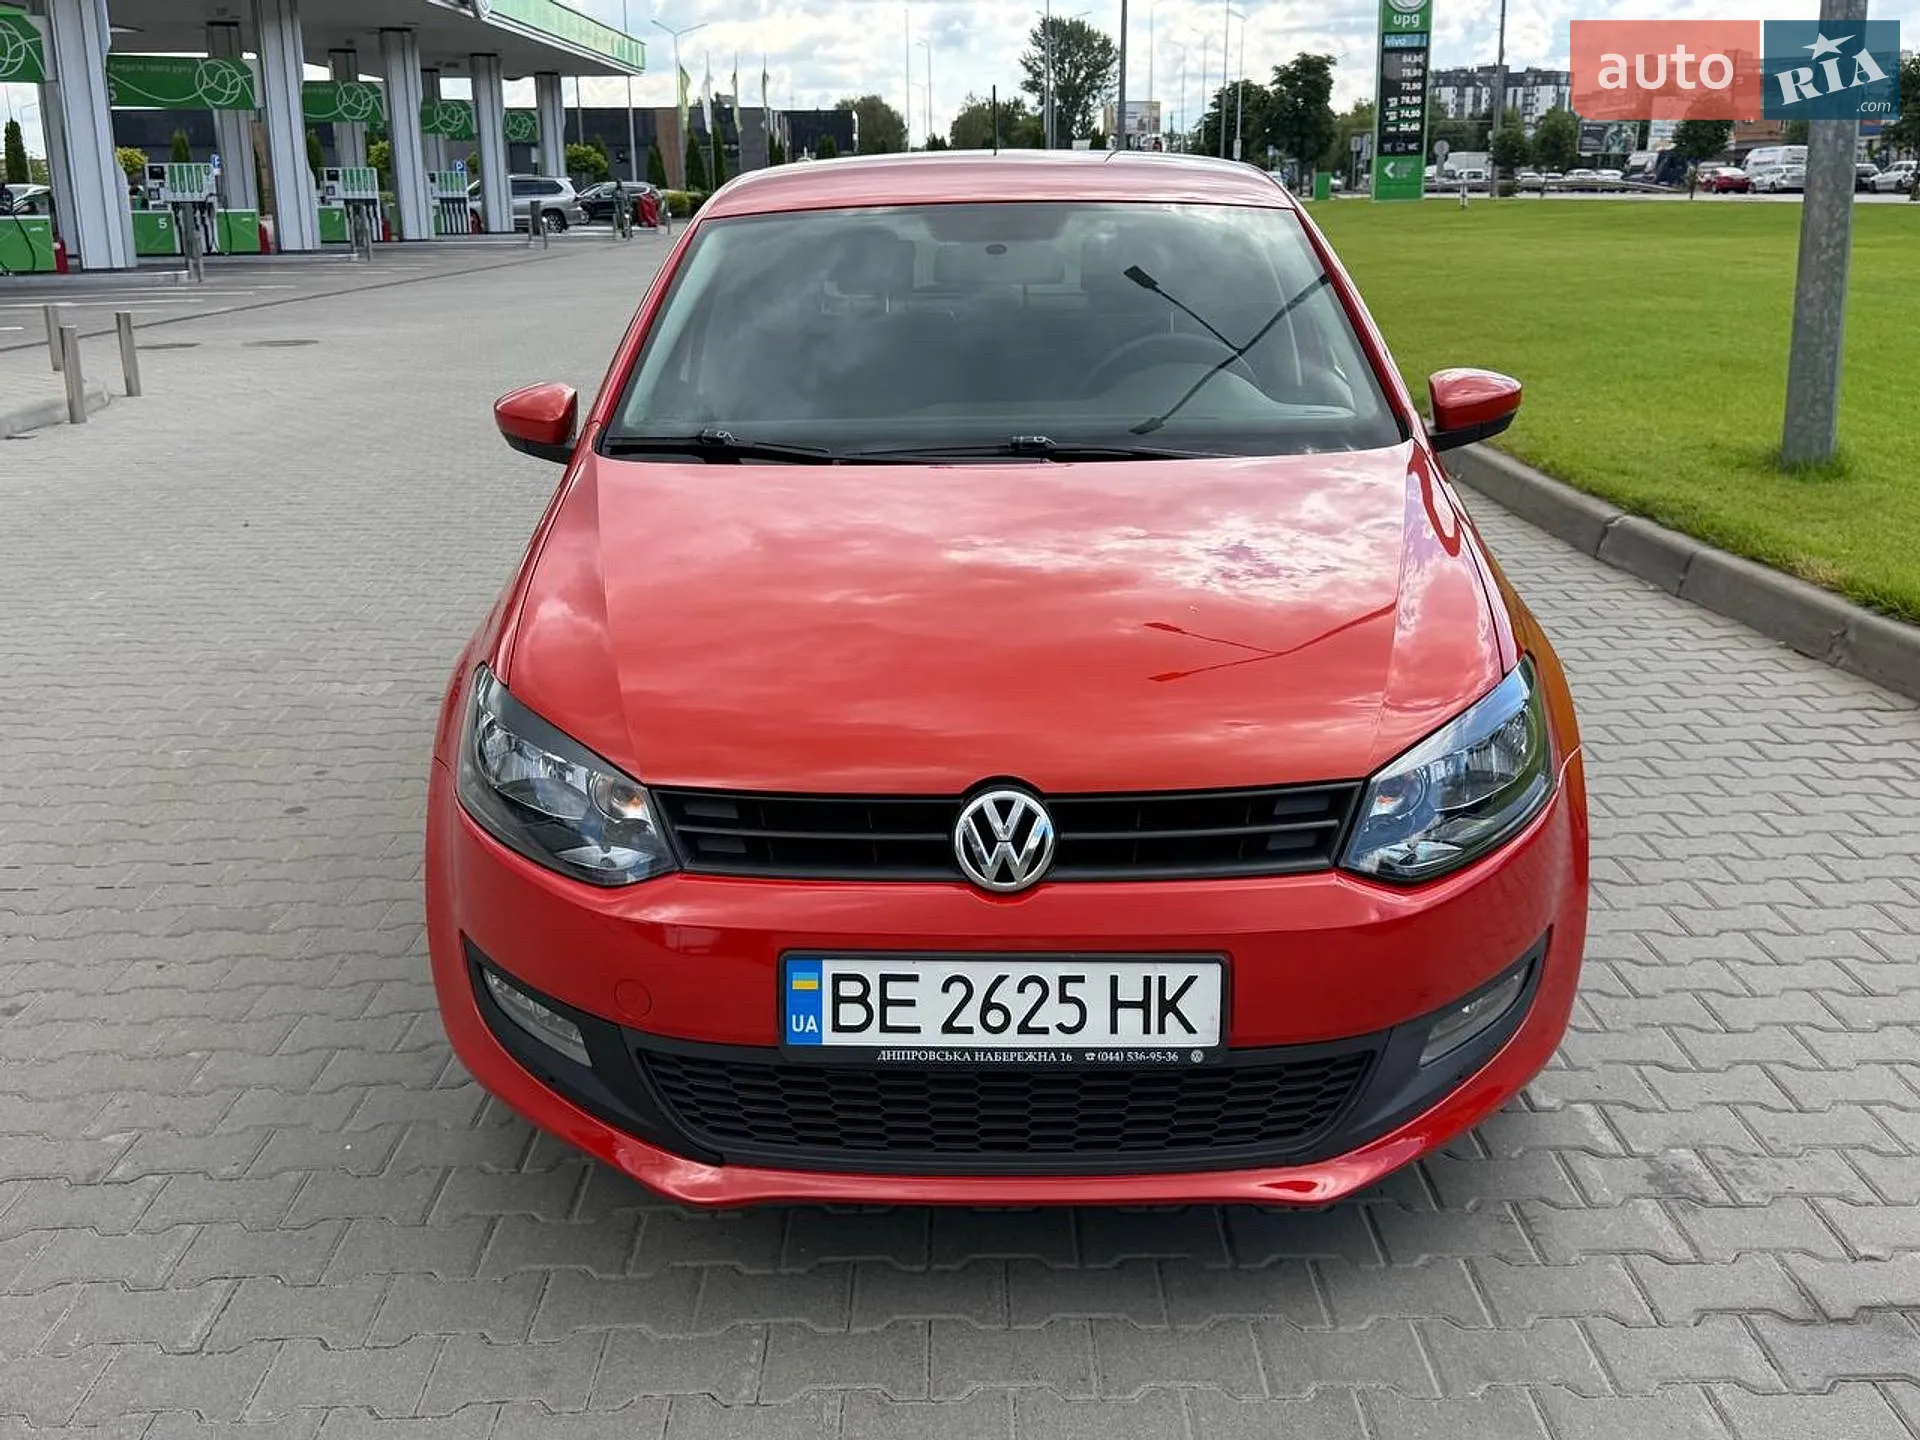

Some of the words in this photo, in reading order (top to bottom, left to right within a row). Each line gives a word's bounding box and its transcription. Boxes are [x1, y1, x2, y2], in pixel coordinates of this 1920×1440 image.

[1393, 13, 1420, 28] upg
[158, 217, 168, 229] 5
[831, 973, 922, 1034] BE
[940, 974, 1087, 1035] 2625
[1109, 974, 1199, 1035] HK
[792, 1014, 819, 1033] UA
[876, 1050, 972, 1062] ДНІПРОВСЬКА
[974, 1051, 1058, 1062] НАБЕРЕЖНА
[1060, 1052, 1072, 1062] 16
[1097, 1051, 1124, 1063] (044)
[1126, 1051, 1179, 1063] 536-95-36
